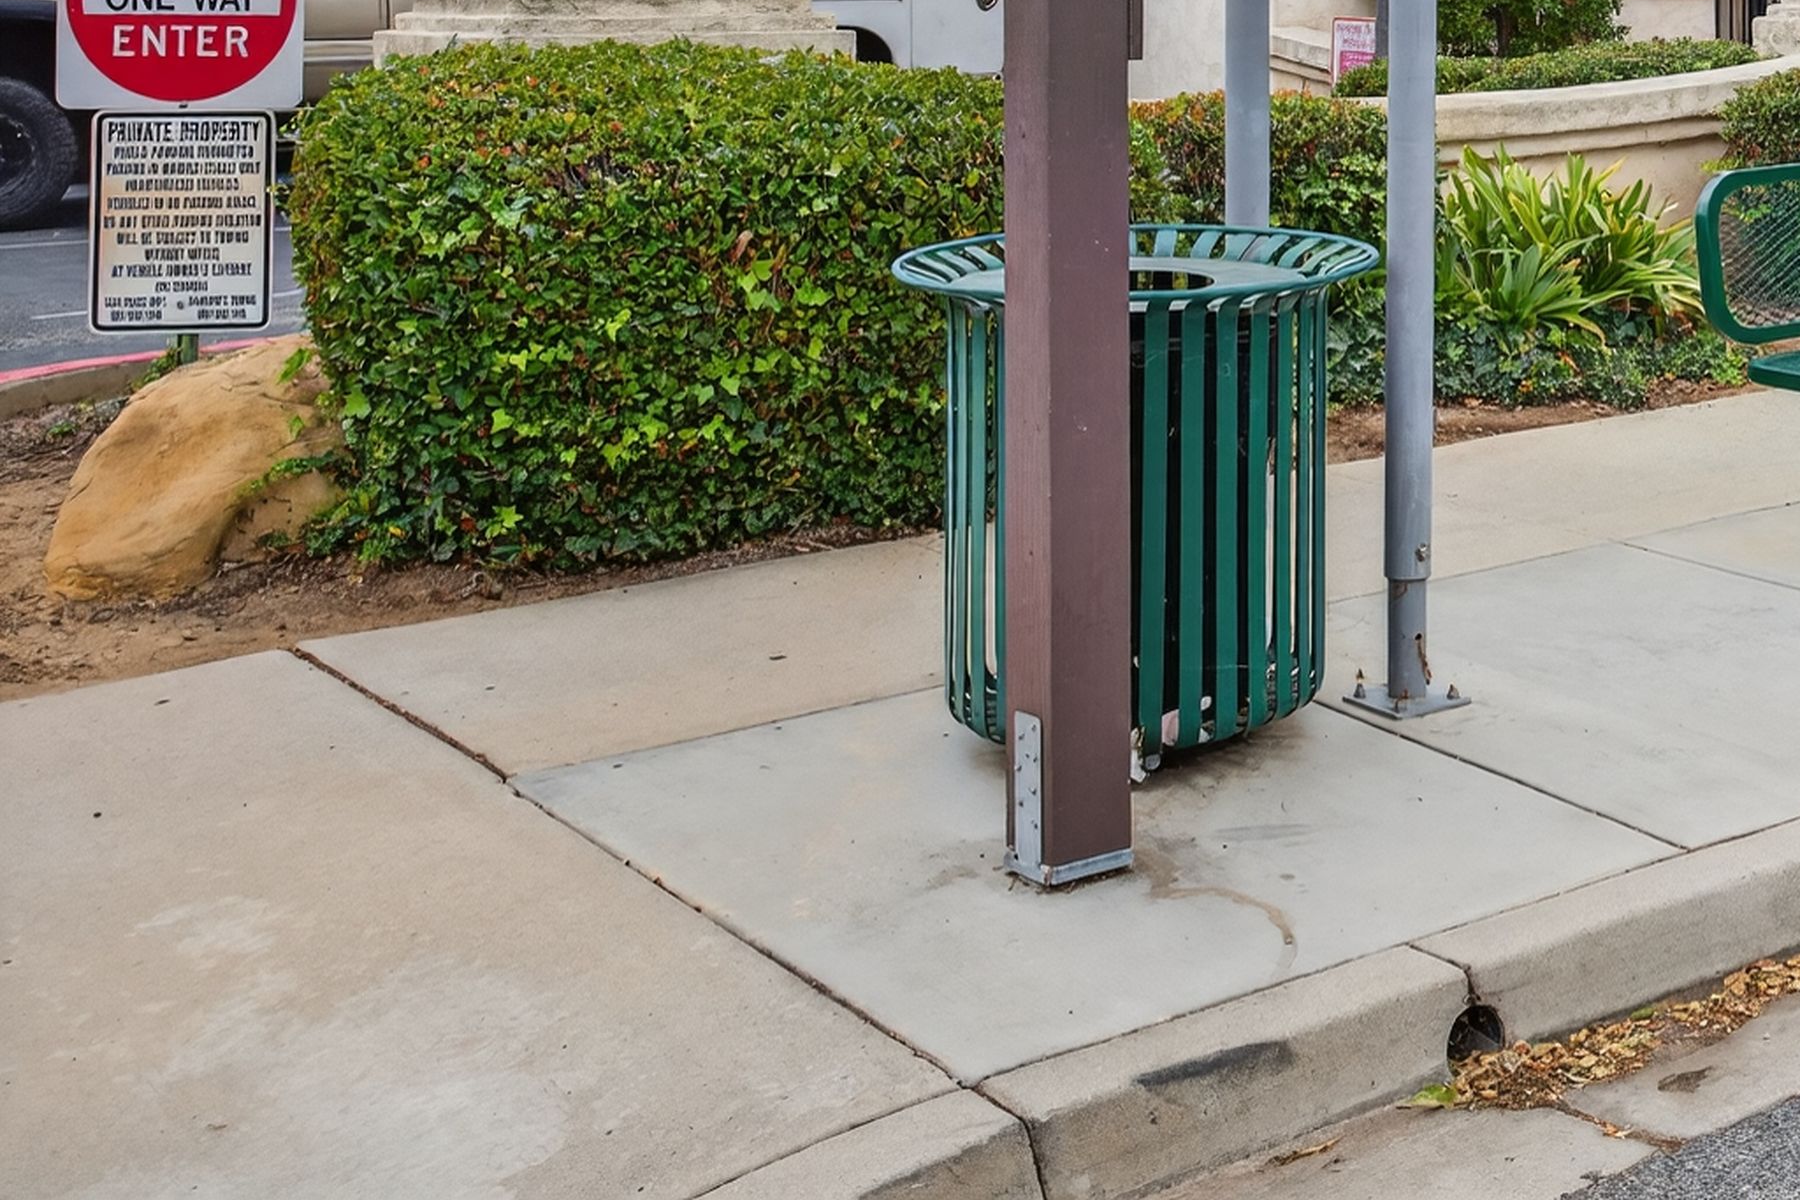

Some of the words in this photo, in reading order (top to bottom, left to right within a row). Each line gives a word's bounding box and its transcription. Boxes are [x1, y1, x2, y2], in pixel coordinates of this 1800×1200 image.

[112, 24, 249, 58] ENTER
[107, 121, 174, 143] PRIVATE
[179, 120, 261, 142] PROPERTY
